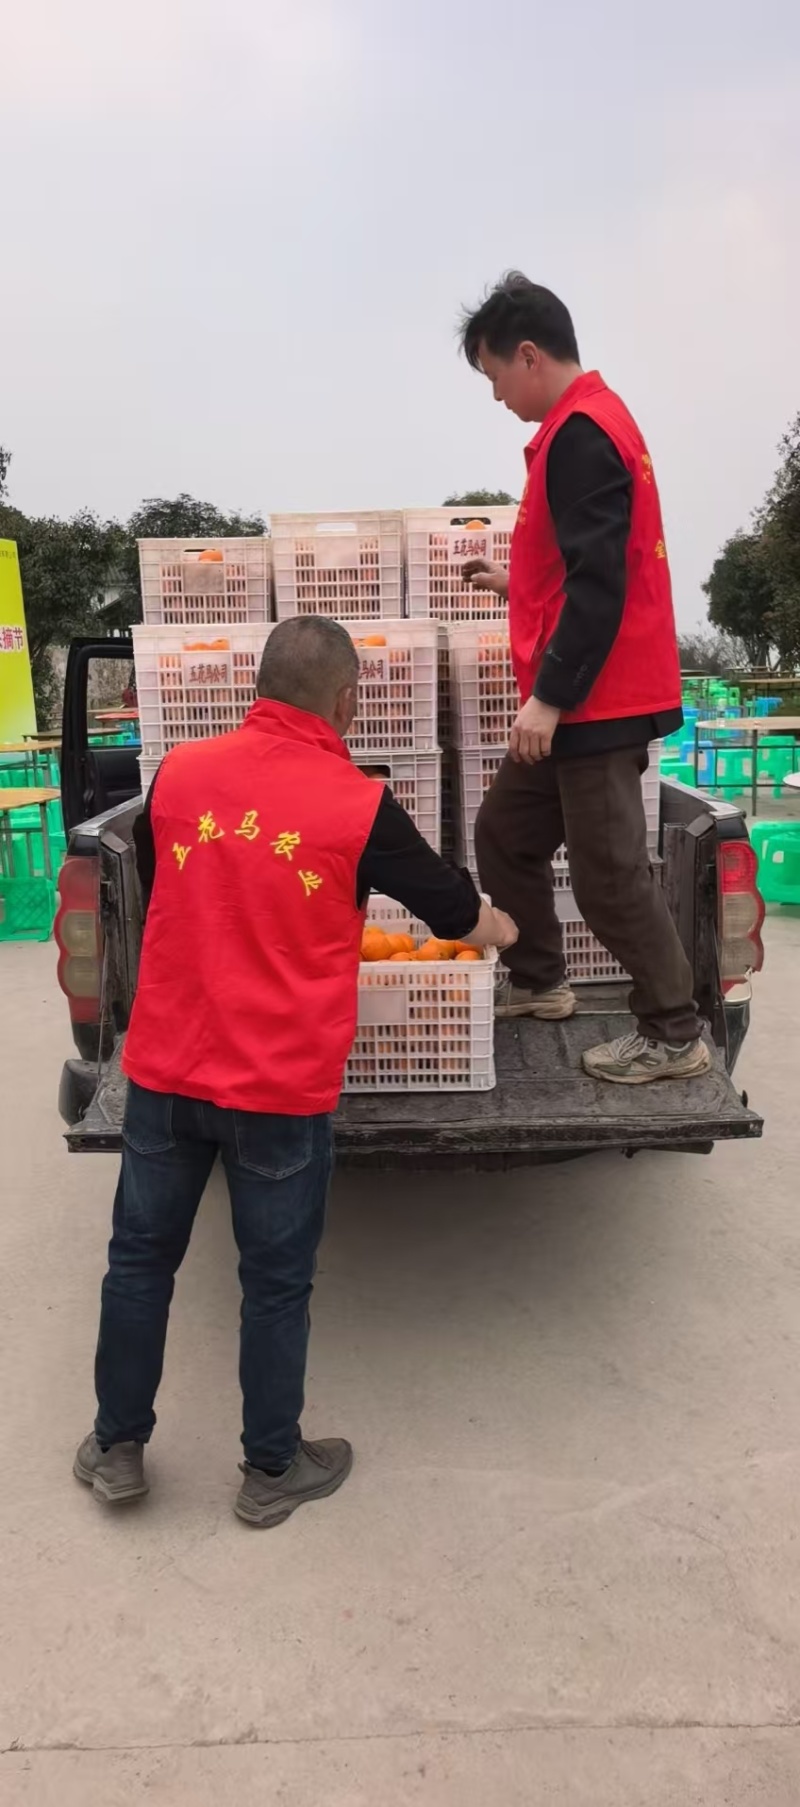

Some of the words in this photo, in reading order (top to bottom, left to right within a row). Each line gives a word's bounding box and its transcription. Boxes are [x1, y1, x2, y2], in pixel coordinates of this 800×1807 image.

[453, 538, 486, 556] 五花马公司
[0, 627, 23, 650] 摘节
[189, 663, 228, 684] 五花马公司
[358, 659, 384, 679] 马公司
